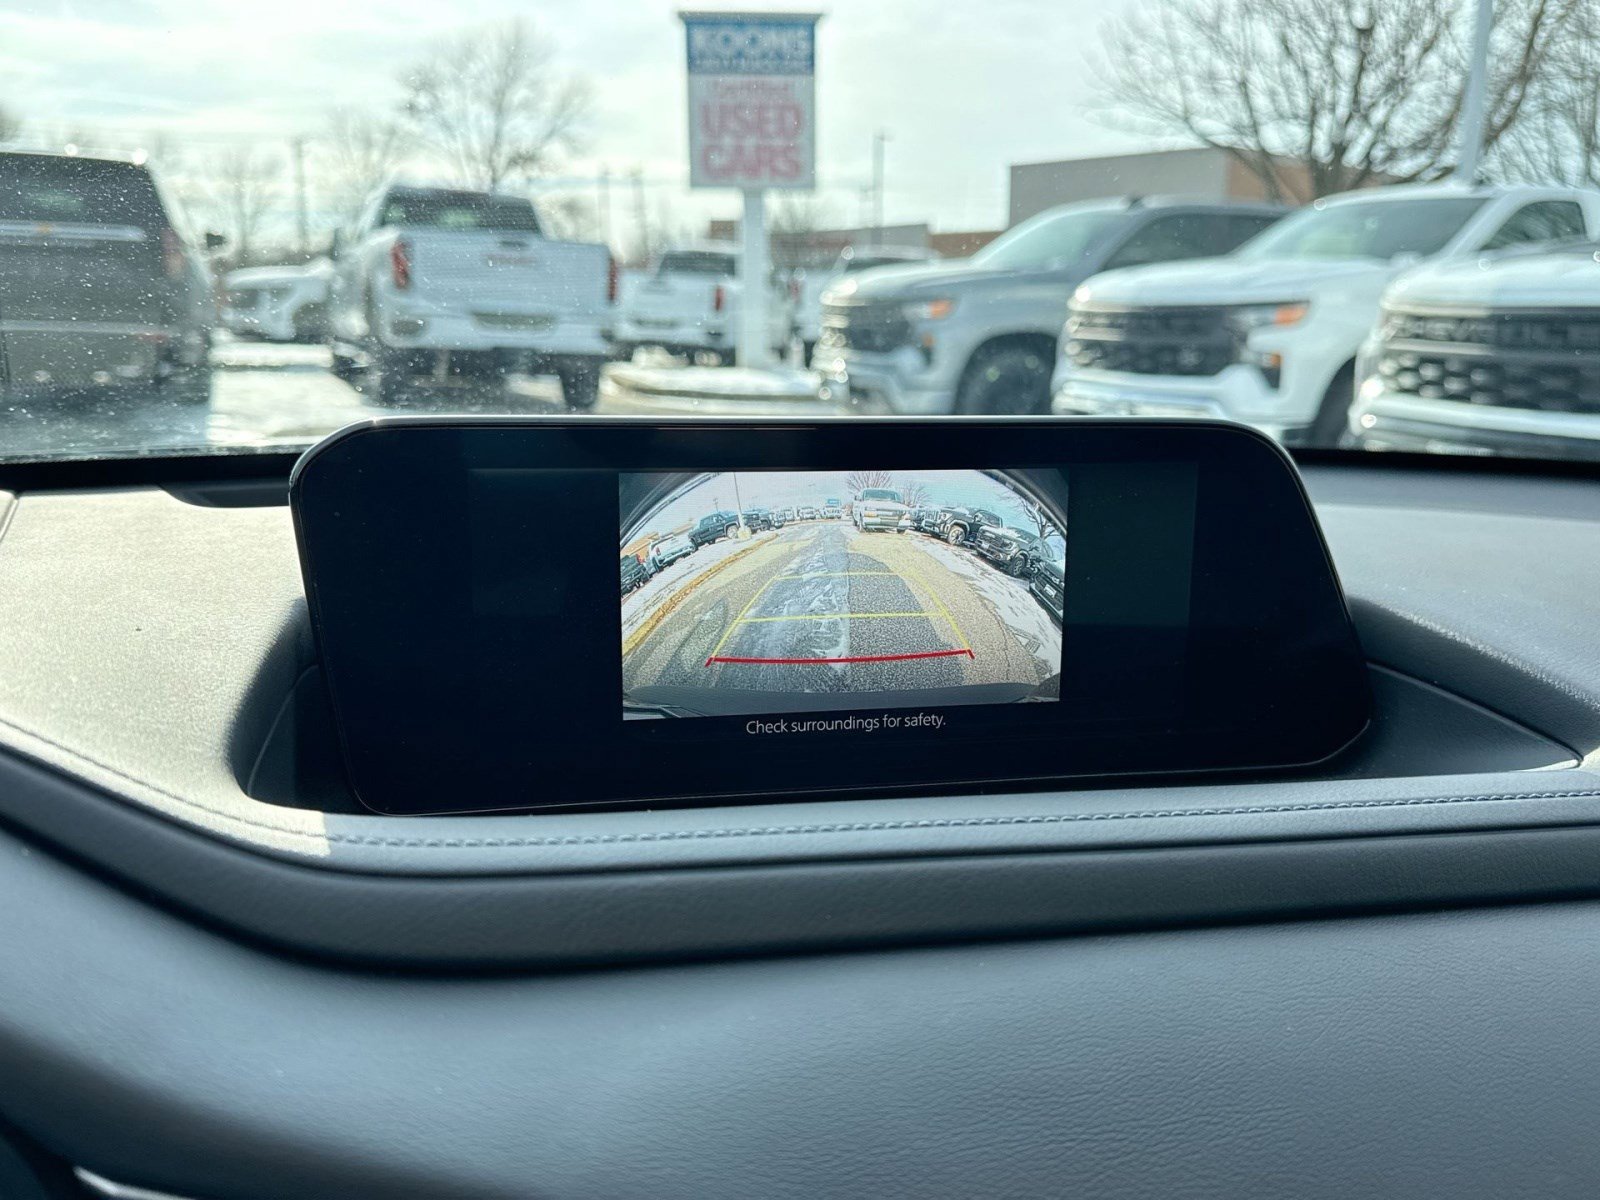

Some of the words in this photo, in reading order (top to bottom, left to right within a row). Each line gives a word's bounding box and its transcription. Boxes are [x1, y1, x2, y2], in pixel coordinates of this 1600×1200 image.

[701, 102, 804, 139] USED
[701, 143, 803, 180] CARS
[746, 719, 788, 734] Check
[791, 716, 880, 732] surroundings
[882, 714, 901, 728] for
[904, 712, 946, 729] safety.
